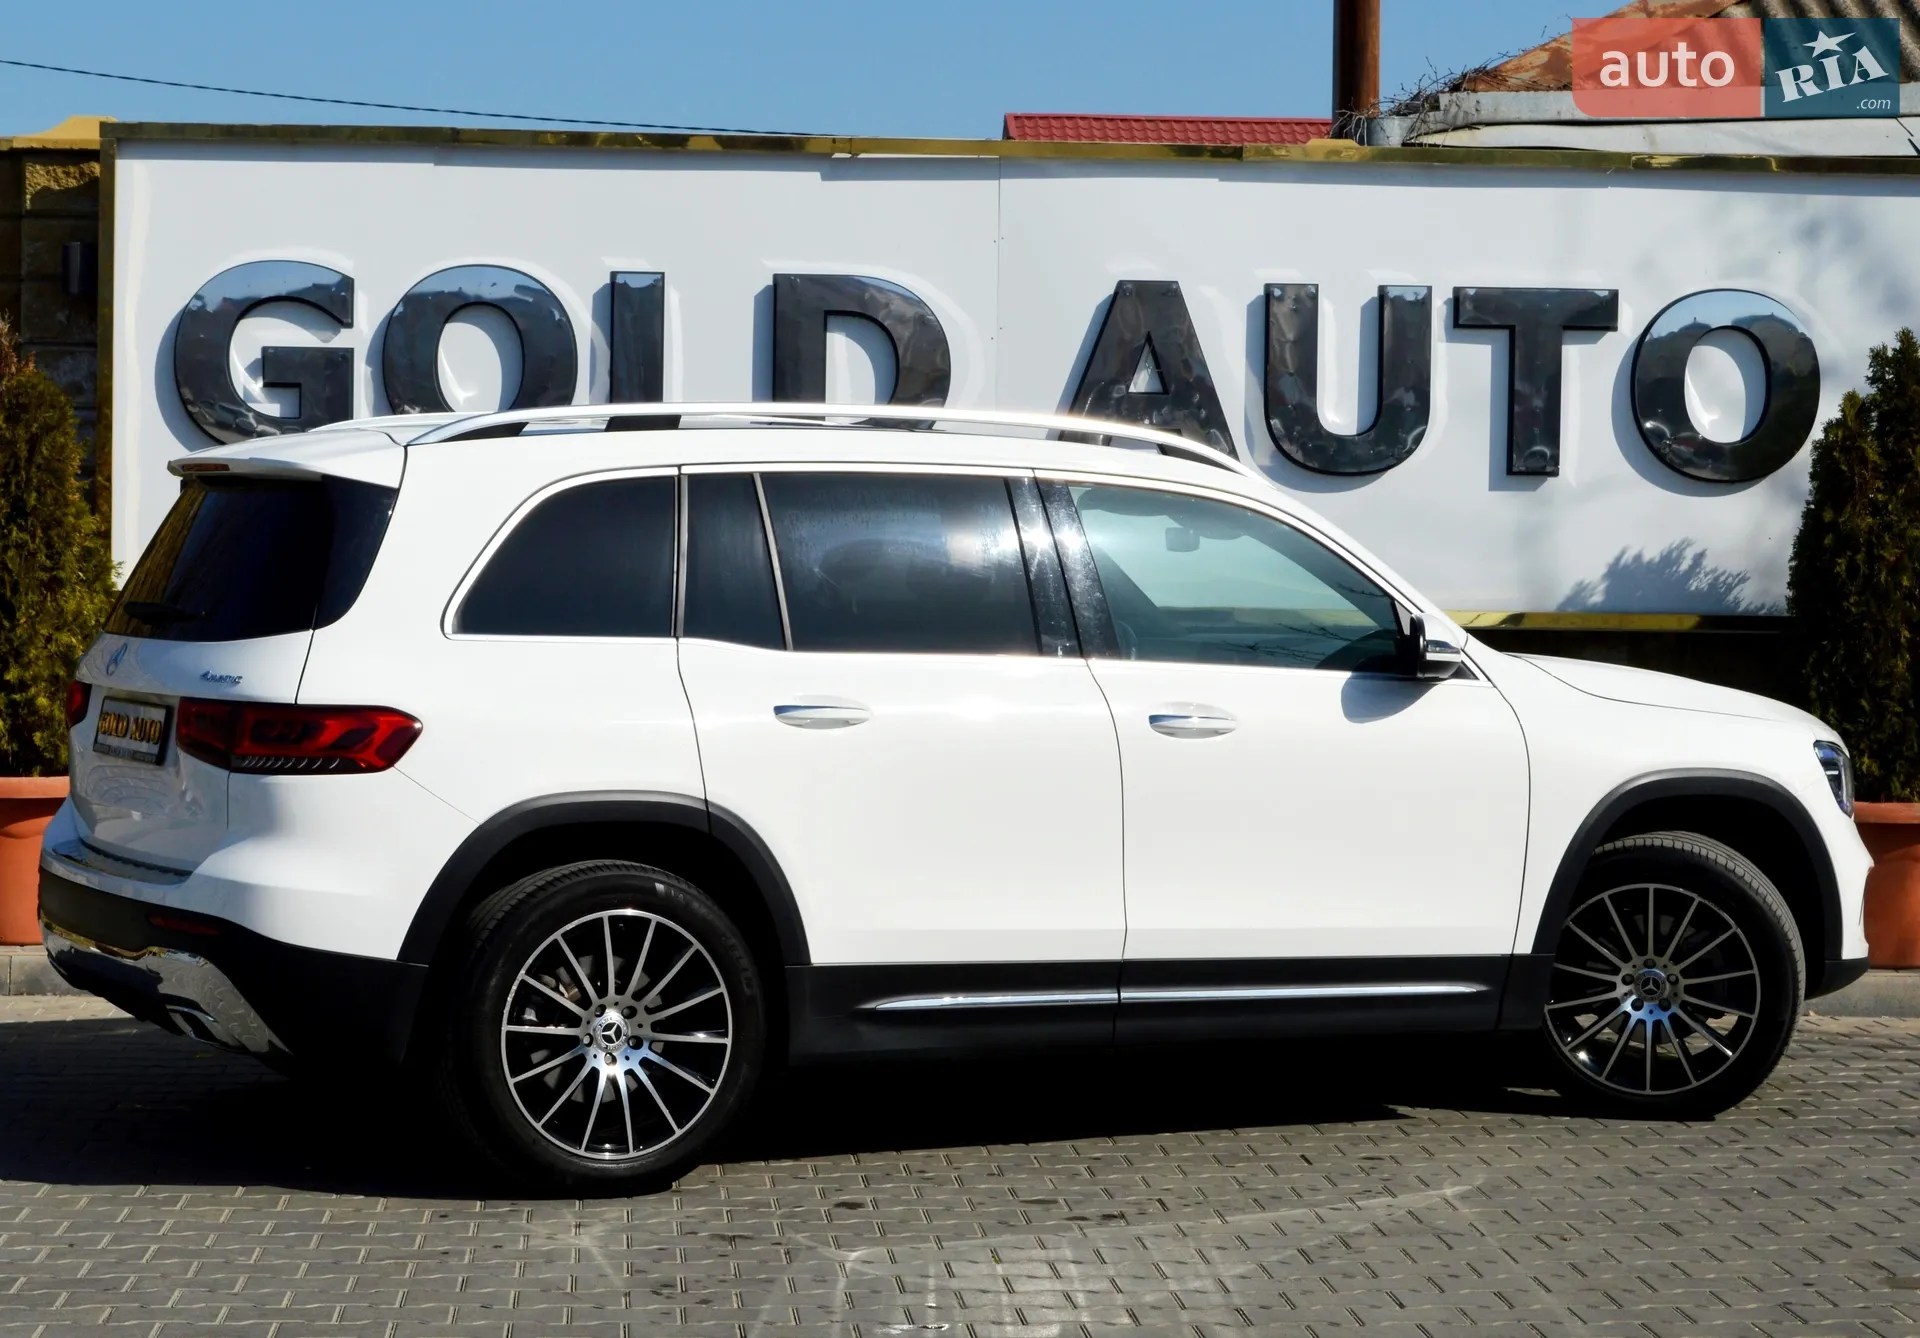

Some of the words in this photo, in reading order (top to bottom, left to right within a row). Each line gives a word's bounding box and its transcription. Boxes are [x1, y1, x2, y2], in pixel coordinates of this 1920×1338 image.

[174, 259, 951, 444] GOLD
[1061, 280, 1821, 484] AUTO
[99, 711, 129, 738] GOLD
[129, 716, 162, 745] AUTO
